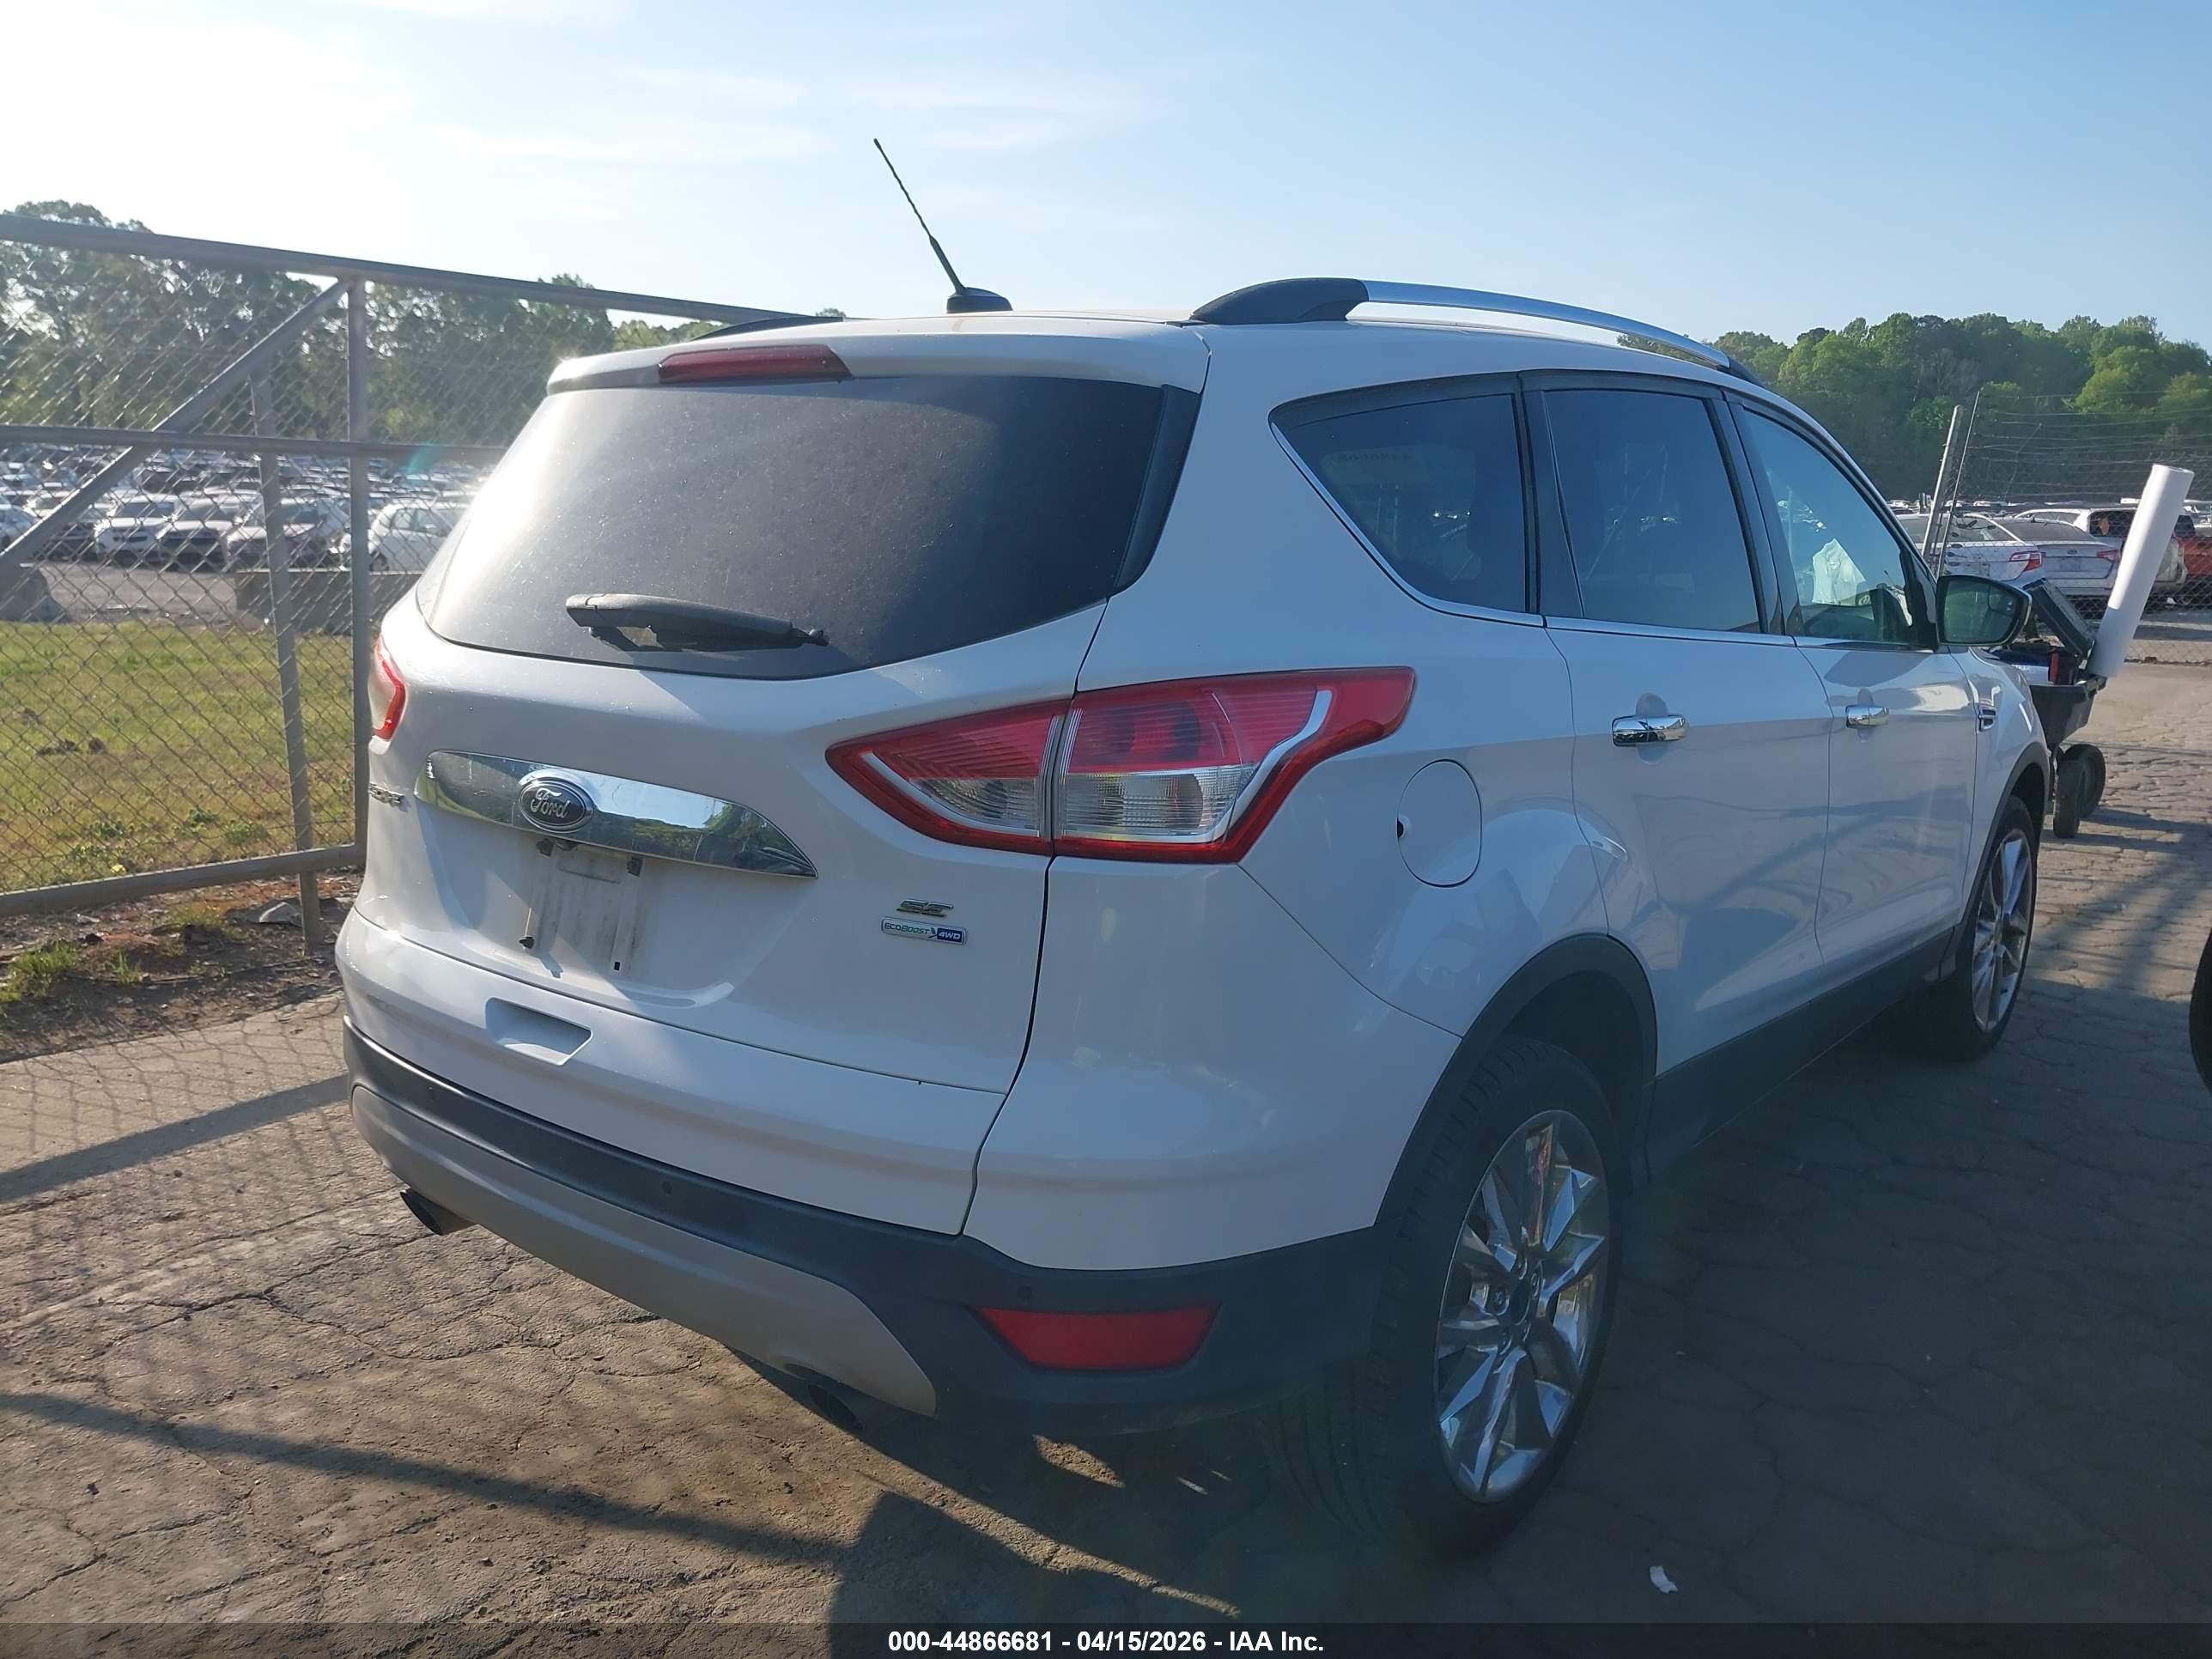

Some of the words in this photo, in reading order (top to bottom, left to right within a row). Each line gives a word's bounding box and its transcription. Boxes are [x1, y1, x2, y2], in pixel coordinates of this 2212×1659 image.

[530, 787, 571, 818] Ford
[896, 898, 954, 918] SE
[939, 930, 962, 941] 4WD
